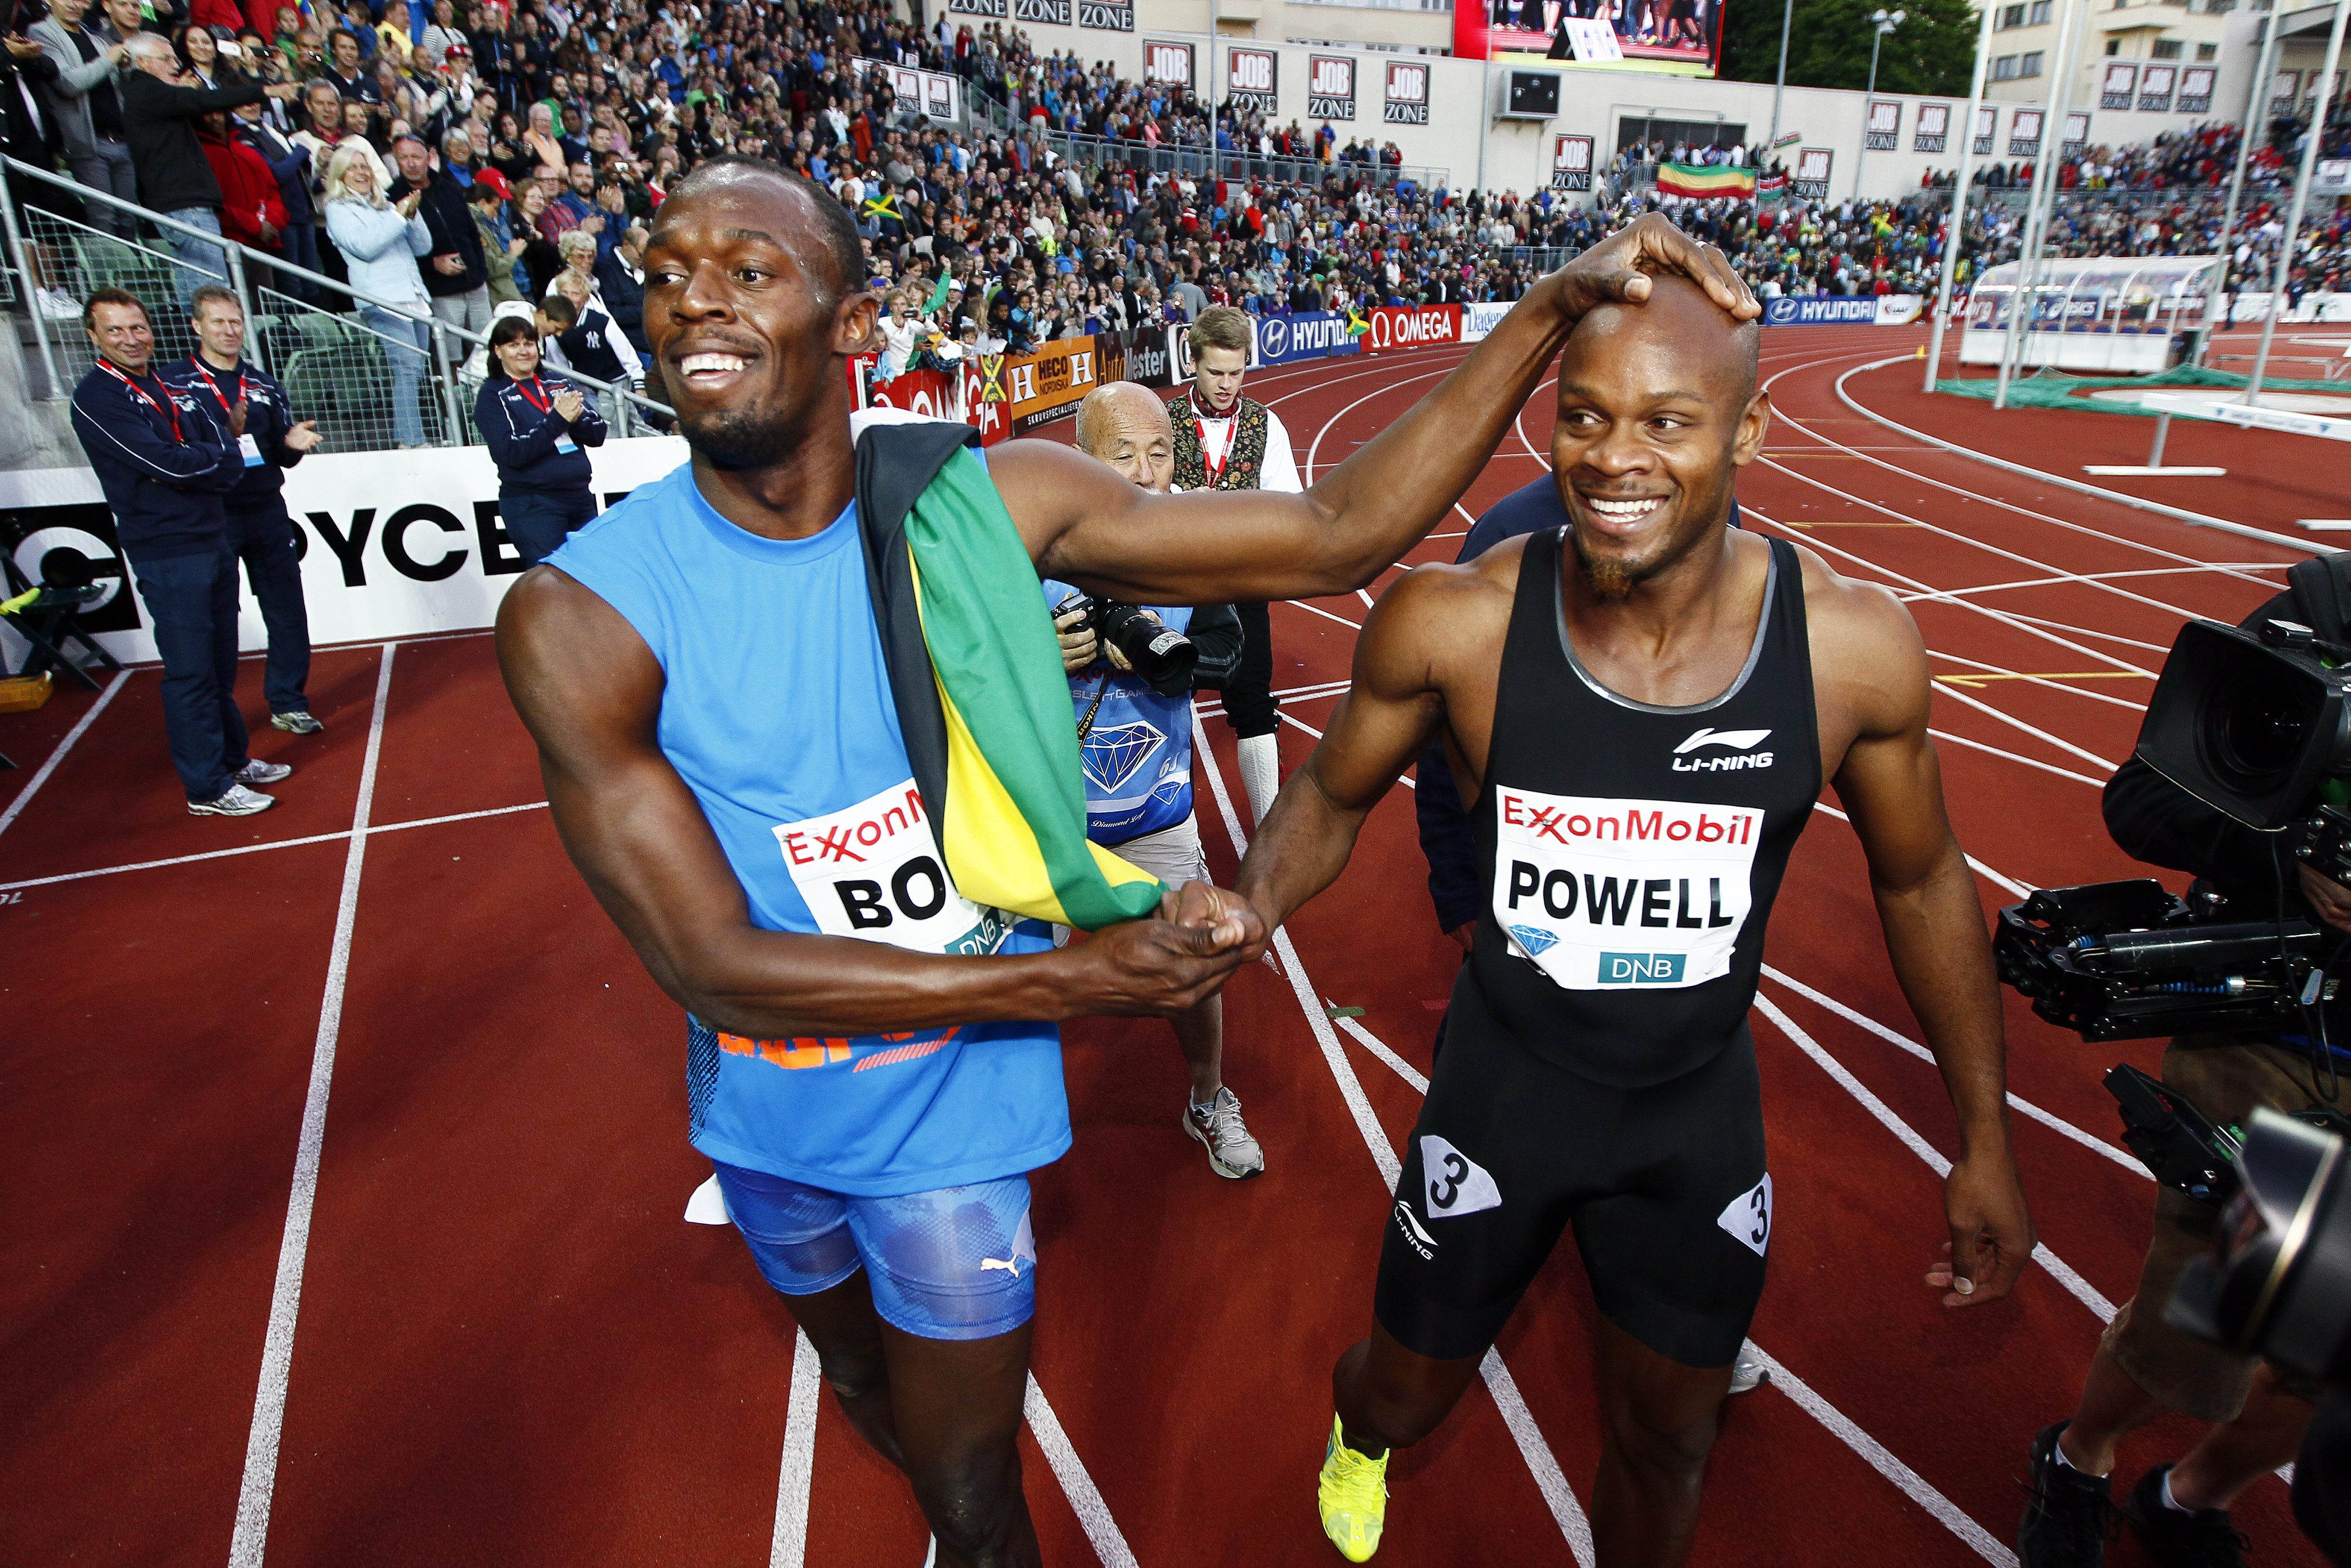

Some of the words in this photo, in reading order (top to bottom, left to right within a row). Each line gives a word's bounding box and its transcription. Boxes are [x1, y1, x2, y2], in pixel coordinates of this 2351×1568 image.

[1017, 0, 1071, 24] ZONE
[1080, 5, 1134, 31] ZONE
[1148, 47, 1188, 81] JOB
[1232, 54, 1270, 88] JOB
[1313, 61, 1349, 94] JOB
[1389, 68, 1423, 99] JOB
[1309, 98, 1355, 119] ZONE
[1385, 104, 1427, 123] ZONE
[1557, 140, 1589, 168] JOB
[1553, 173, 1591, 189] ZONE
[1395, 309, 1453, 343] OMEGA
[1801, 301, 1876, 321] HYUNDAI
[1293, 319, 1359, 351] HYUND
[1011, 363, 1037, 404] H
[1038, 355, 1069, 381] HECO
[1070, 351, 1093, 386] H
[1672, 751, 1774, 772] LI-NING
[1091, 818, 1130, 828] Diamond
[1504, 795, 1753, 845] ExxonMobil
[833, 855, 946, 930] BO
[1508, 859, 1735, 929] POWELL
[959, 917, 996, 955] DNB
[1612, 957, 1673, 979] DNB
[1430, 1152, 1469, 1209] 3
[1751, 1184, 1768, 1244] 3
[1394, 1206, 1434, 1260] LI-NING
